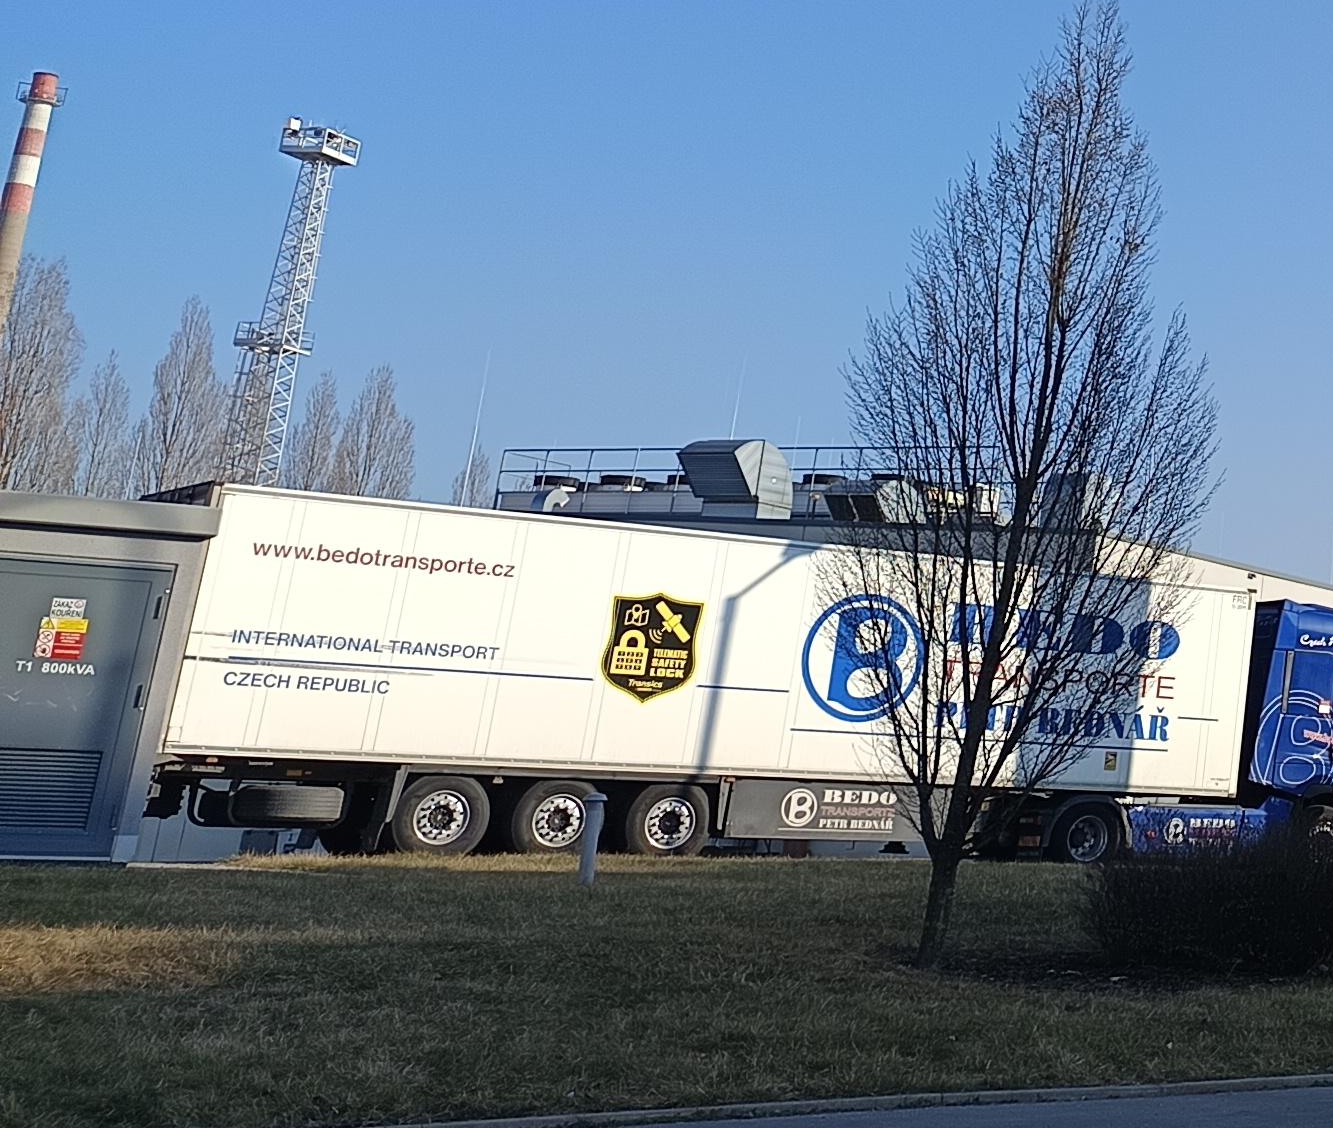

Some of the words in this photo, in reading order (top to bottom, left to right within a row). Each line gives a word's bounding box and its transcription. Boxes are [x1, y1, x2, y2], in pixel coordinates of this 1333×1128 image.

[252, 541, 516, 578] www.bedotransporte.cz
[230, 629, 384, 653] INTERNATIONAL
[388, 640, 500, 660] TRANSPORT
[15, 660, 33, 672] T1
[41, 662, 95, 676] 800kVA
[651, 658, 687, 669] SAFETY
[649, 667, 685, 679] LOCK
[223, 670, 291, 689] CZECH
[296, 675, 391, 695] REPUBLIC
[822, 788, 897, 805] BEDO
[820, 805, 896, 818] TRANSPORTE
[819, 818, 847, 829] PETR
